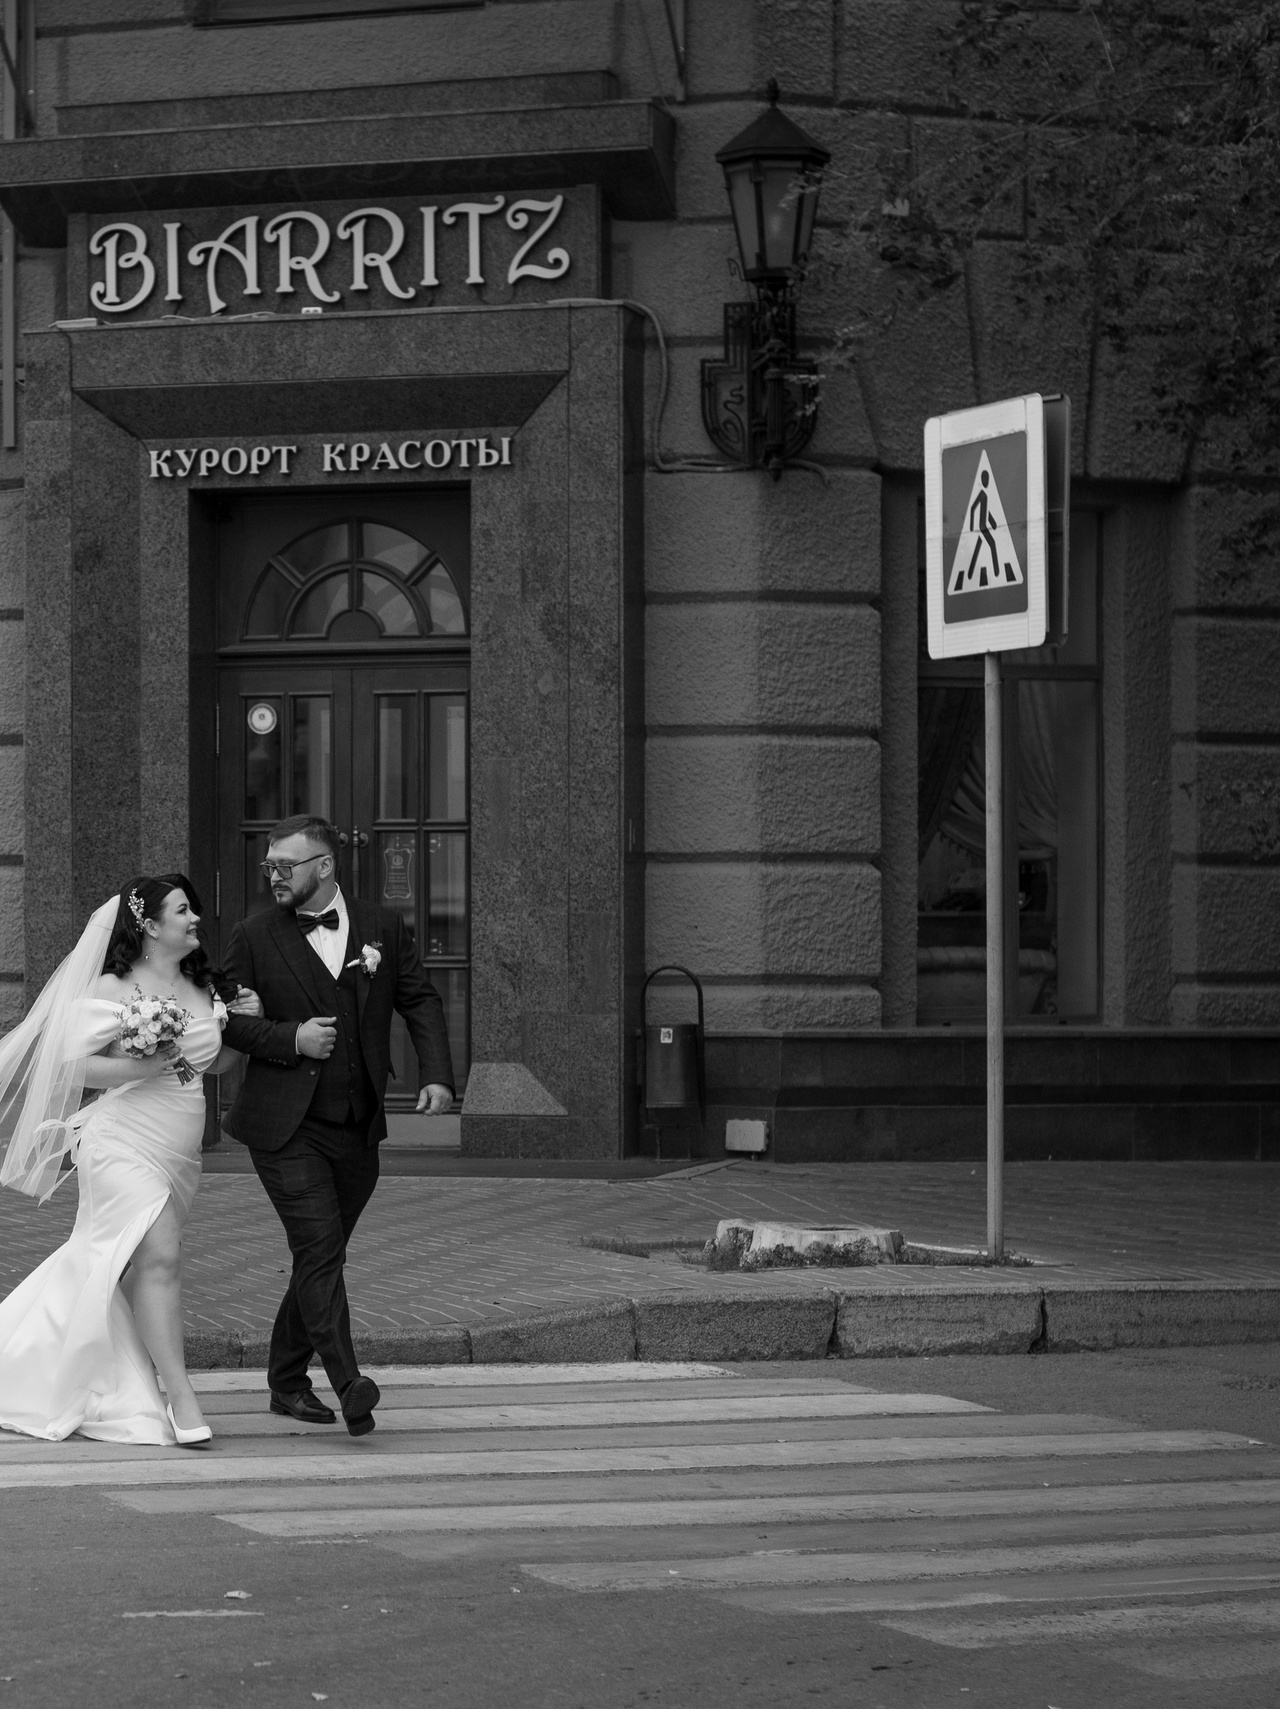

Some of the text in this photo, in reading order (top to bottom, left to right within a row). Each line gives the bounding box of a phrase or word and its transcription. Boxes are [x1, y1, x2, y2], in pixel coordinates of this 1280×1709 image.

[89, 194, 570, 314] BIARRITZ
[149, 437, 512, 478] КУРОРТ КРАСОТЫ
